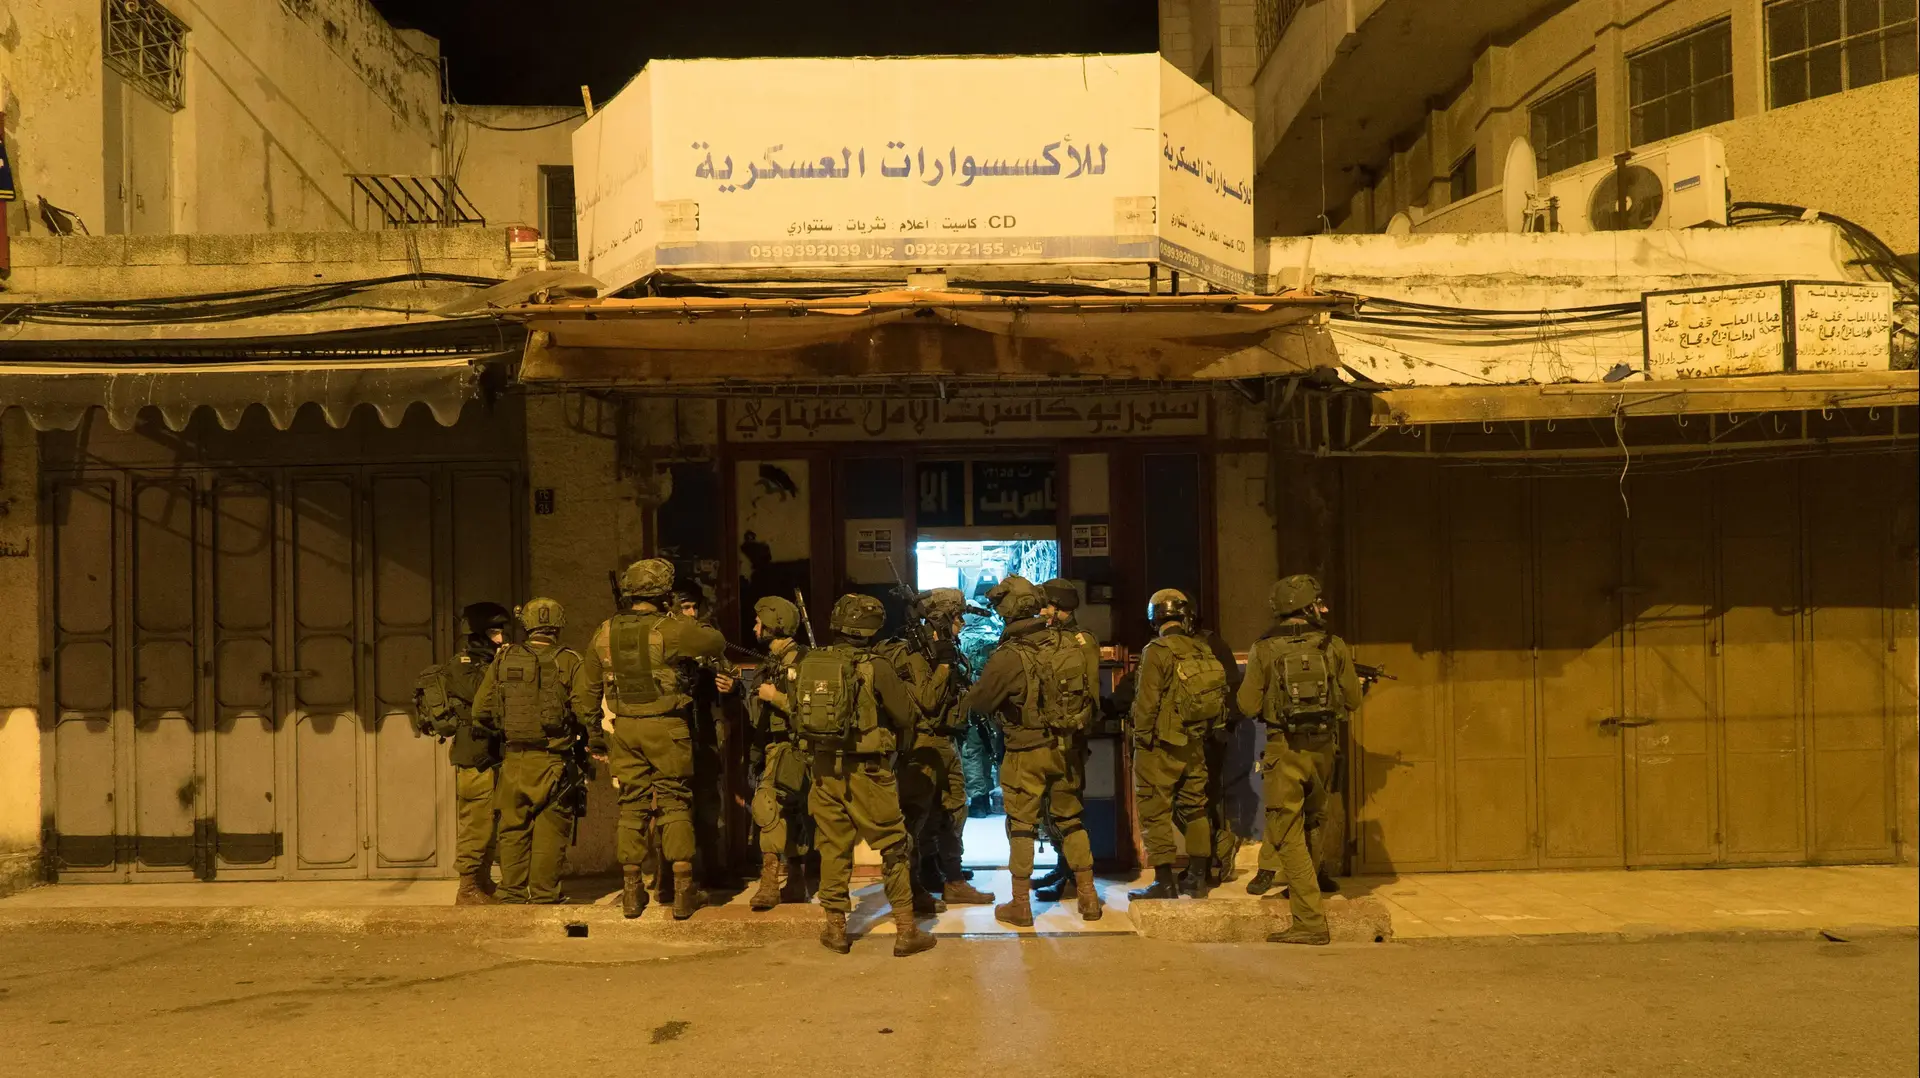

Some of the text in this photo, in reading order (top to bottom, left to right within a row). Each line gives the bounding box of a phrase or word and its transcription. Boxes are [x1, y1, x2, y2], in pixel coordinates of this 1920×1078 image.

[691, 141, 866, 194] العسكرية
[846, 216, 887, 234] نثريات
[941, 217, 977, 233] كاسيت
[988, 215, 1017, 229] CD
[750, 244, 861, 259] 0599392039
[866, 245, 895, 260] جوال
[905, 243, 1004, 257] 092372155
[1236, 239, 1246, 253] CD
[1159, 241, 1199, 268] 0599392039
[1655, 317, 1680, 333] عطور
[1688, 316, 1713, 330] تحف
